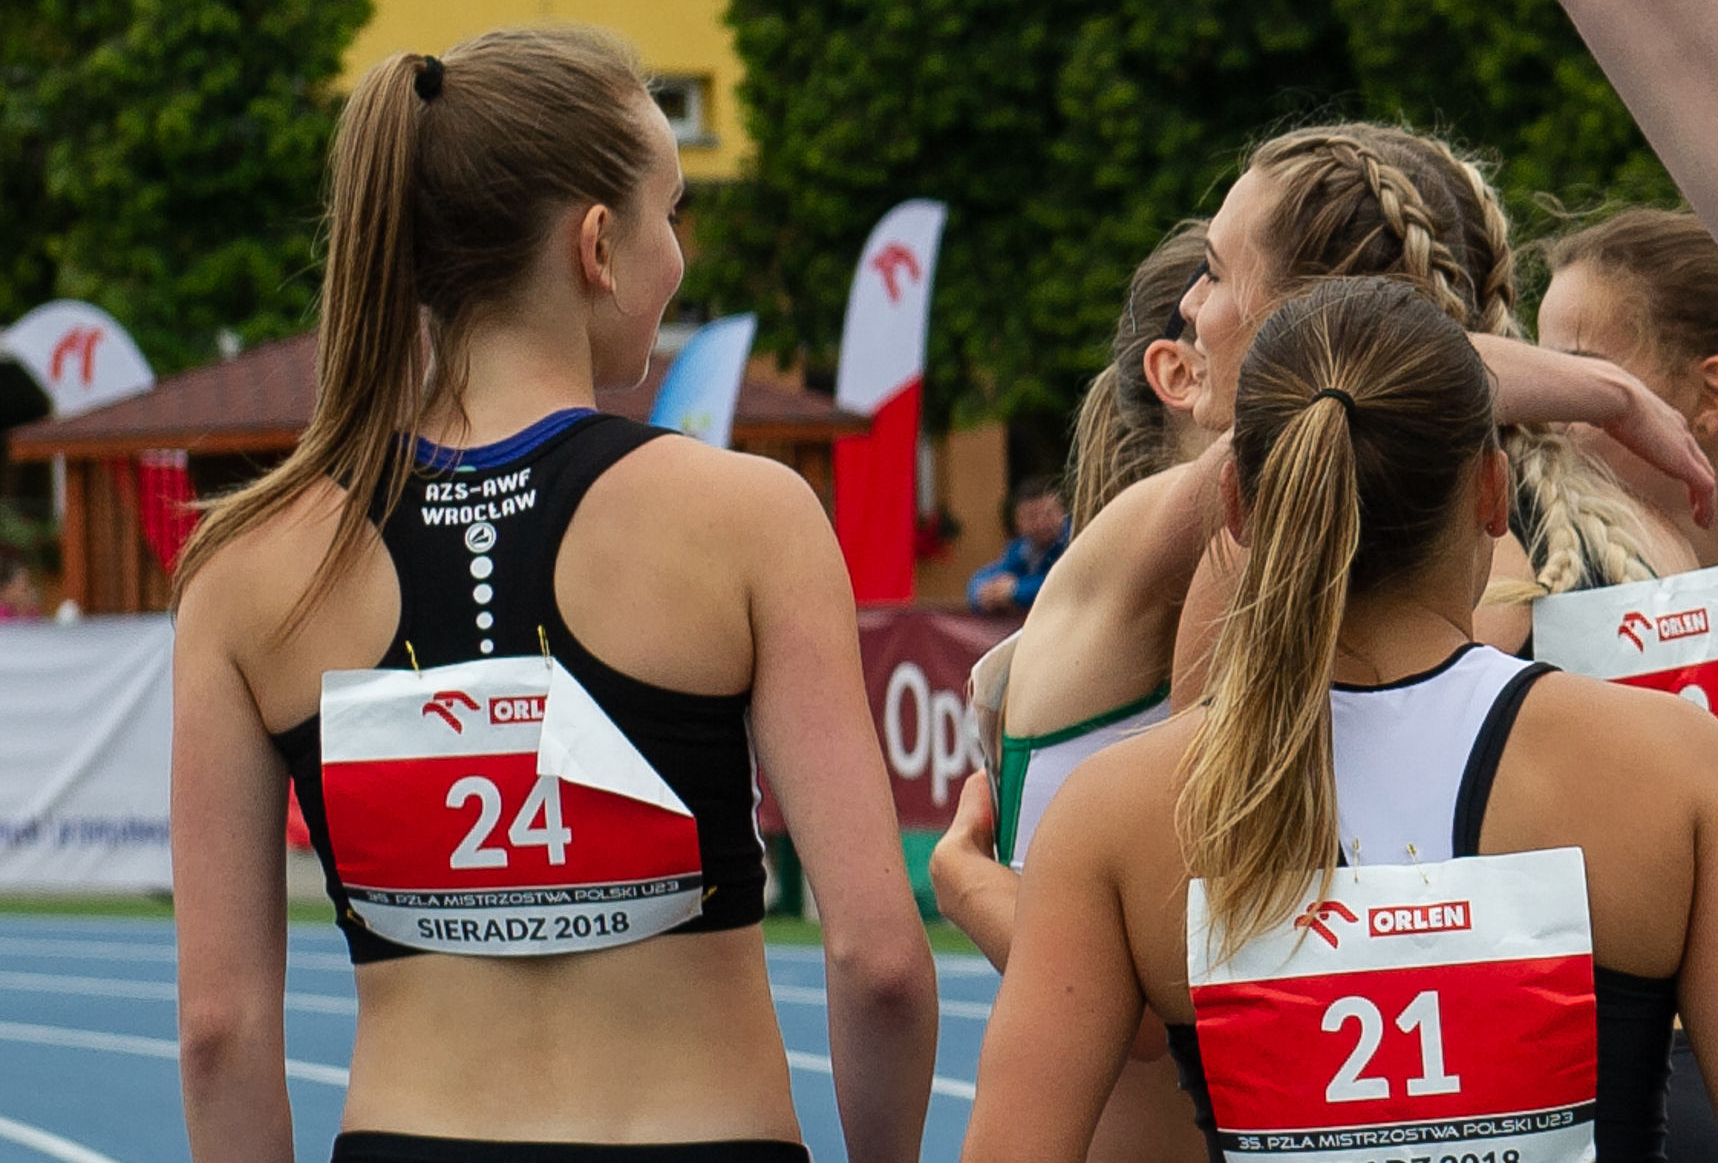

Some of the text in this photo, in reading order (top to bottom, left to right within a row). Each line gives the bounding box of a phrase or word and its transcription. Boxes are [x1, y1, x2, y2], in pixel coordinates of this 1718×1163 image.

[425, 468, 531, 501] AZS-AWF
[421, 489, 536, 525] WROCŁAW
[1659, 612, 1706, 638] ORLEN
[493, 699, 547, 722] ORL
[445, 775, 572, 870] 24
[395, 893, 440, 906] PZLA
[443, 891, 572, 907] MISTRZOSTWA
[574, 885, 638, 901] POLSKI
[641, 880, 680, 896] U23
[417, 912, 630, 942] SIERADZ 2018
[1373, 905, 1465, 933] ORLEN
[1320, 990, 1461, 1103] 21
[1267, 1136, 1315, 1150] PZLA
[1318, 1125, 1460, 1148] MISTRZOSTWA
[1463, 1117, 1532, 1137] POLSKI
[1536, 1111, 1574, 1129] U23
